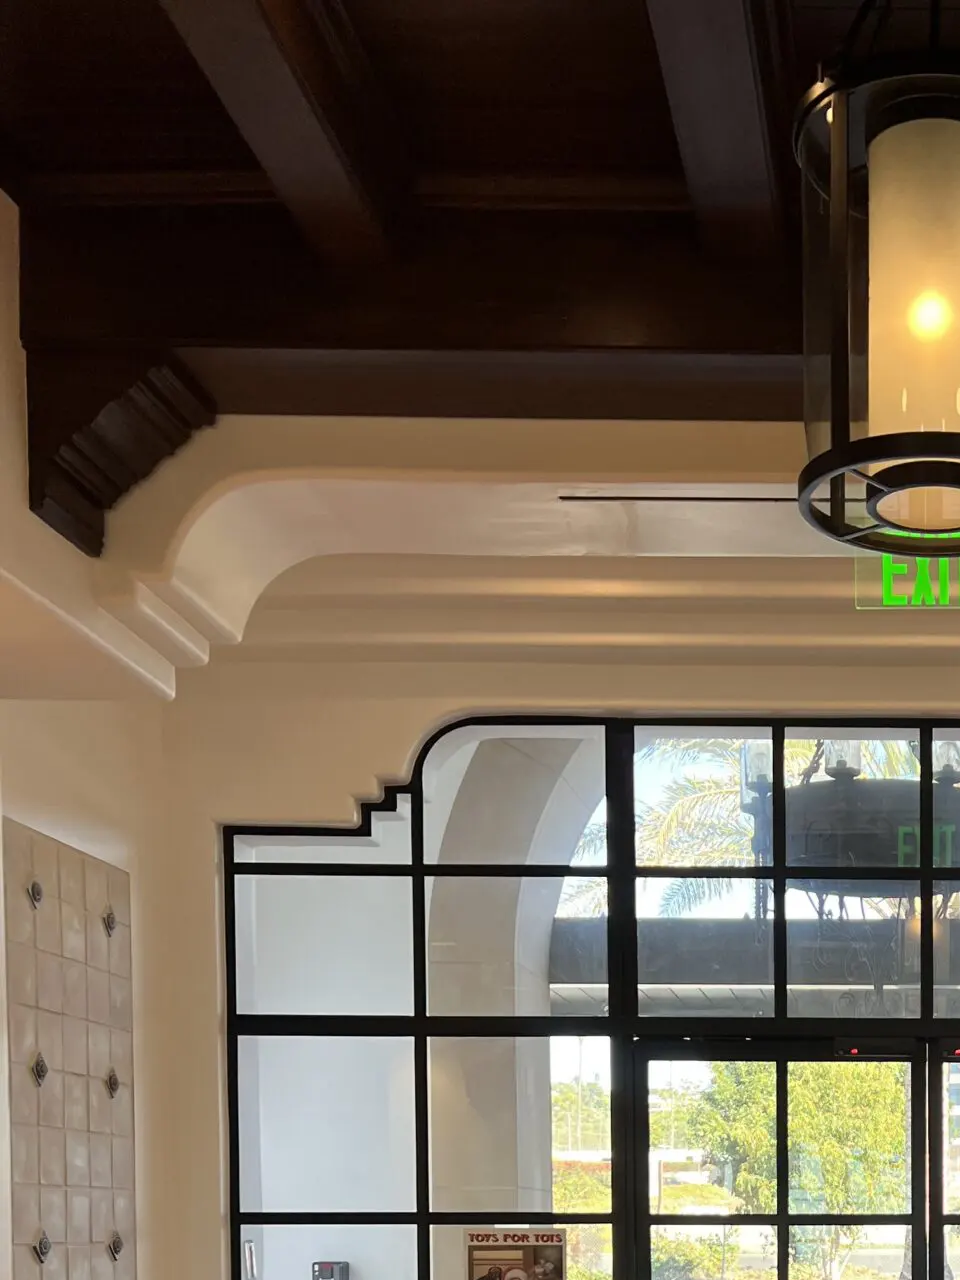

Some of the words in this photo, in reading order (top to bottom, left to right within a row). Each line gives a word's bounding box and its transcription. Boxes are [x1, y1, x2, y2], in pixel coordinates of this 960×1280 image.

[897, 825, 956, 868] EIT
[467, 1233, 499, 1243] TOYS
[503, 1233, 530, 1243] FOR
[534, 1233, 563, 1243] TOTS
